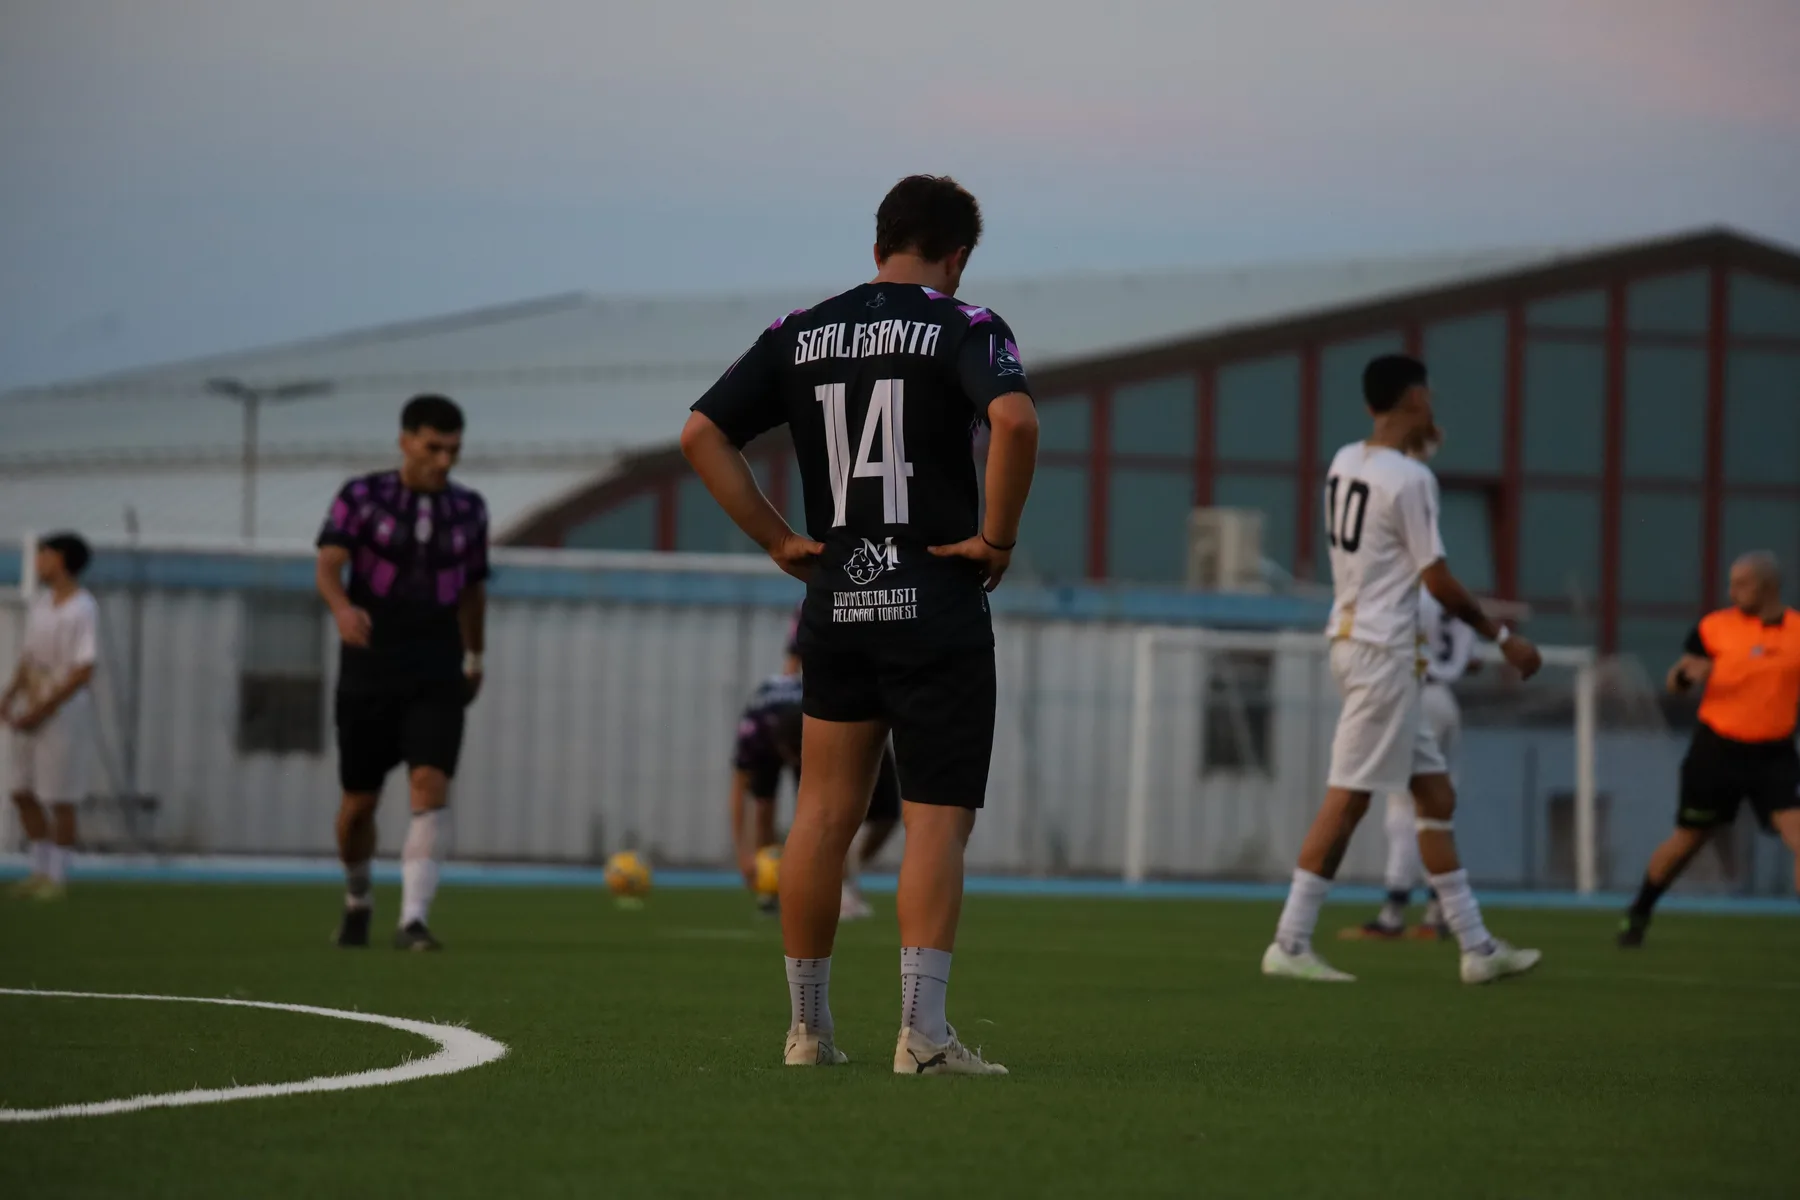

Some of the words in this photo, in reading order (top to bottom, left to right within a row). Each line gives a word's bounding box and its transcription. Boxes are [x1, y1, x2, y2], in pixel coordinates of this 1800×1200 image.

[795, 319, 941, 365] SCALASANTA
[814, 378, 914, 527] 14
[1329, 476, 1369, 553] 10
[833, 588, 917, 607] COMMERCIALISTI
[878, 605, 917, 621] TORRESI
